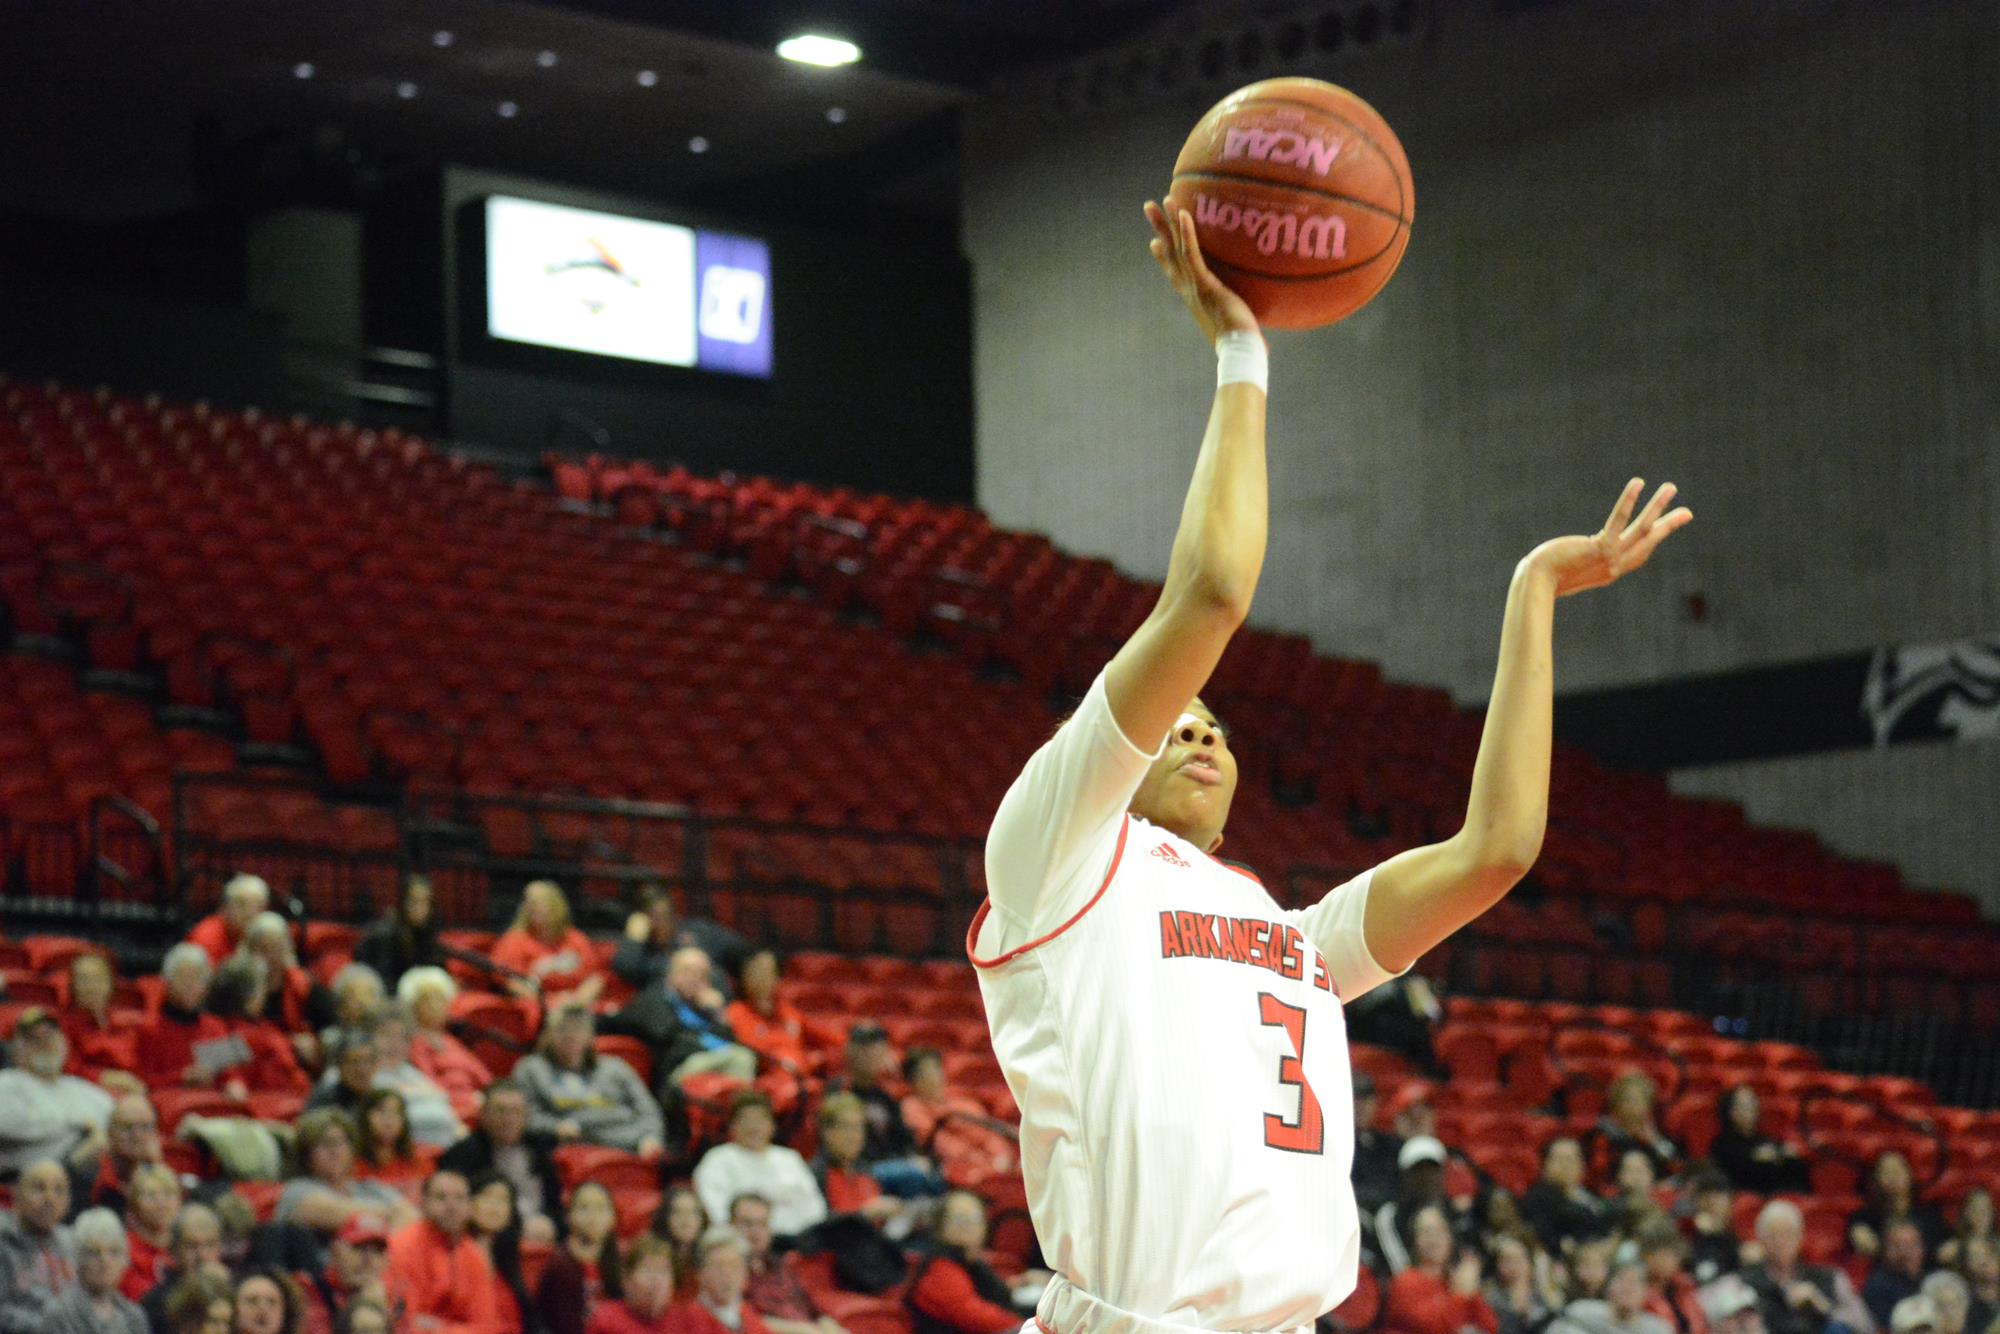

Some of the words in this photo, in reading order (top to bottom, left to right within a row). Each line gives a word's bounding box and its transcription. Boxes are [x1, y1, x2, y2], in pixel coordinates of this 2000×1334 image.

[1223, 128, 1342, 177] NCAA
[1195, 194, 1346, 260] Wilson
[1159, 910, 1303, 981] ARKANSAS
[1257, 991, 1324, 1156] 3
